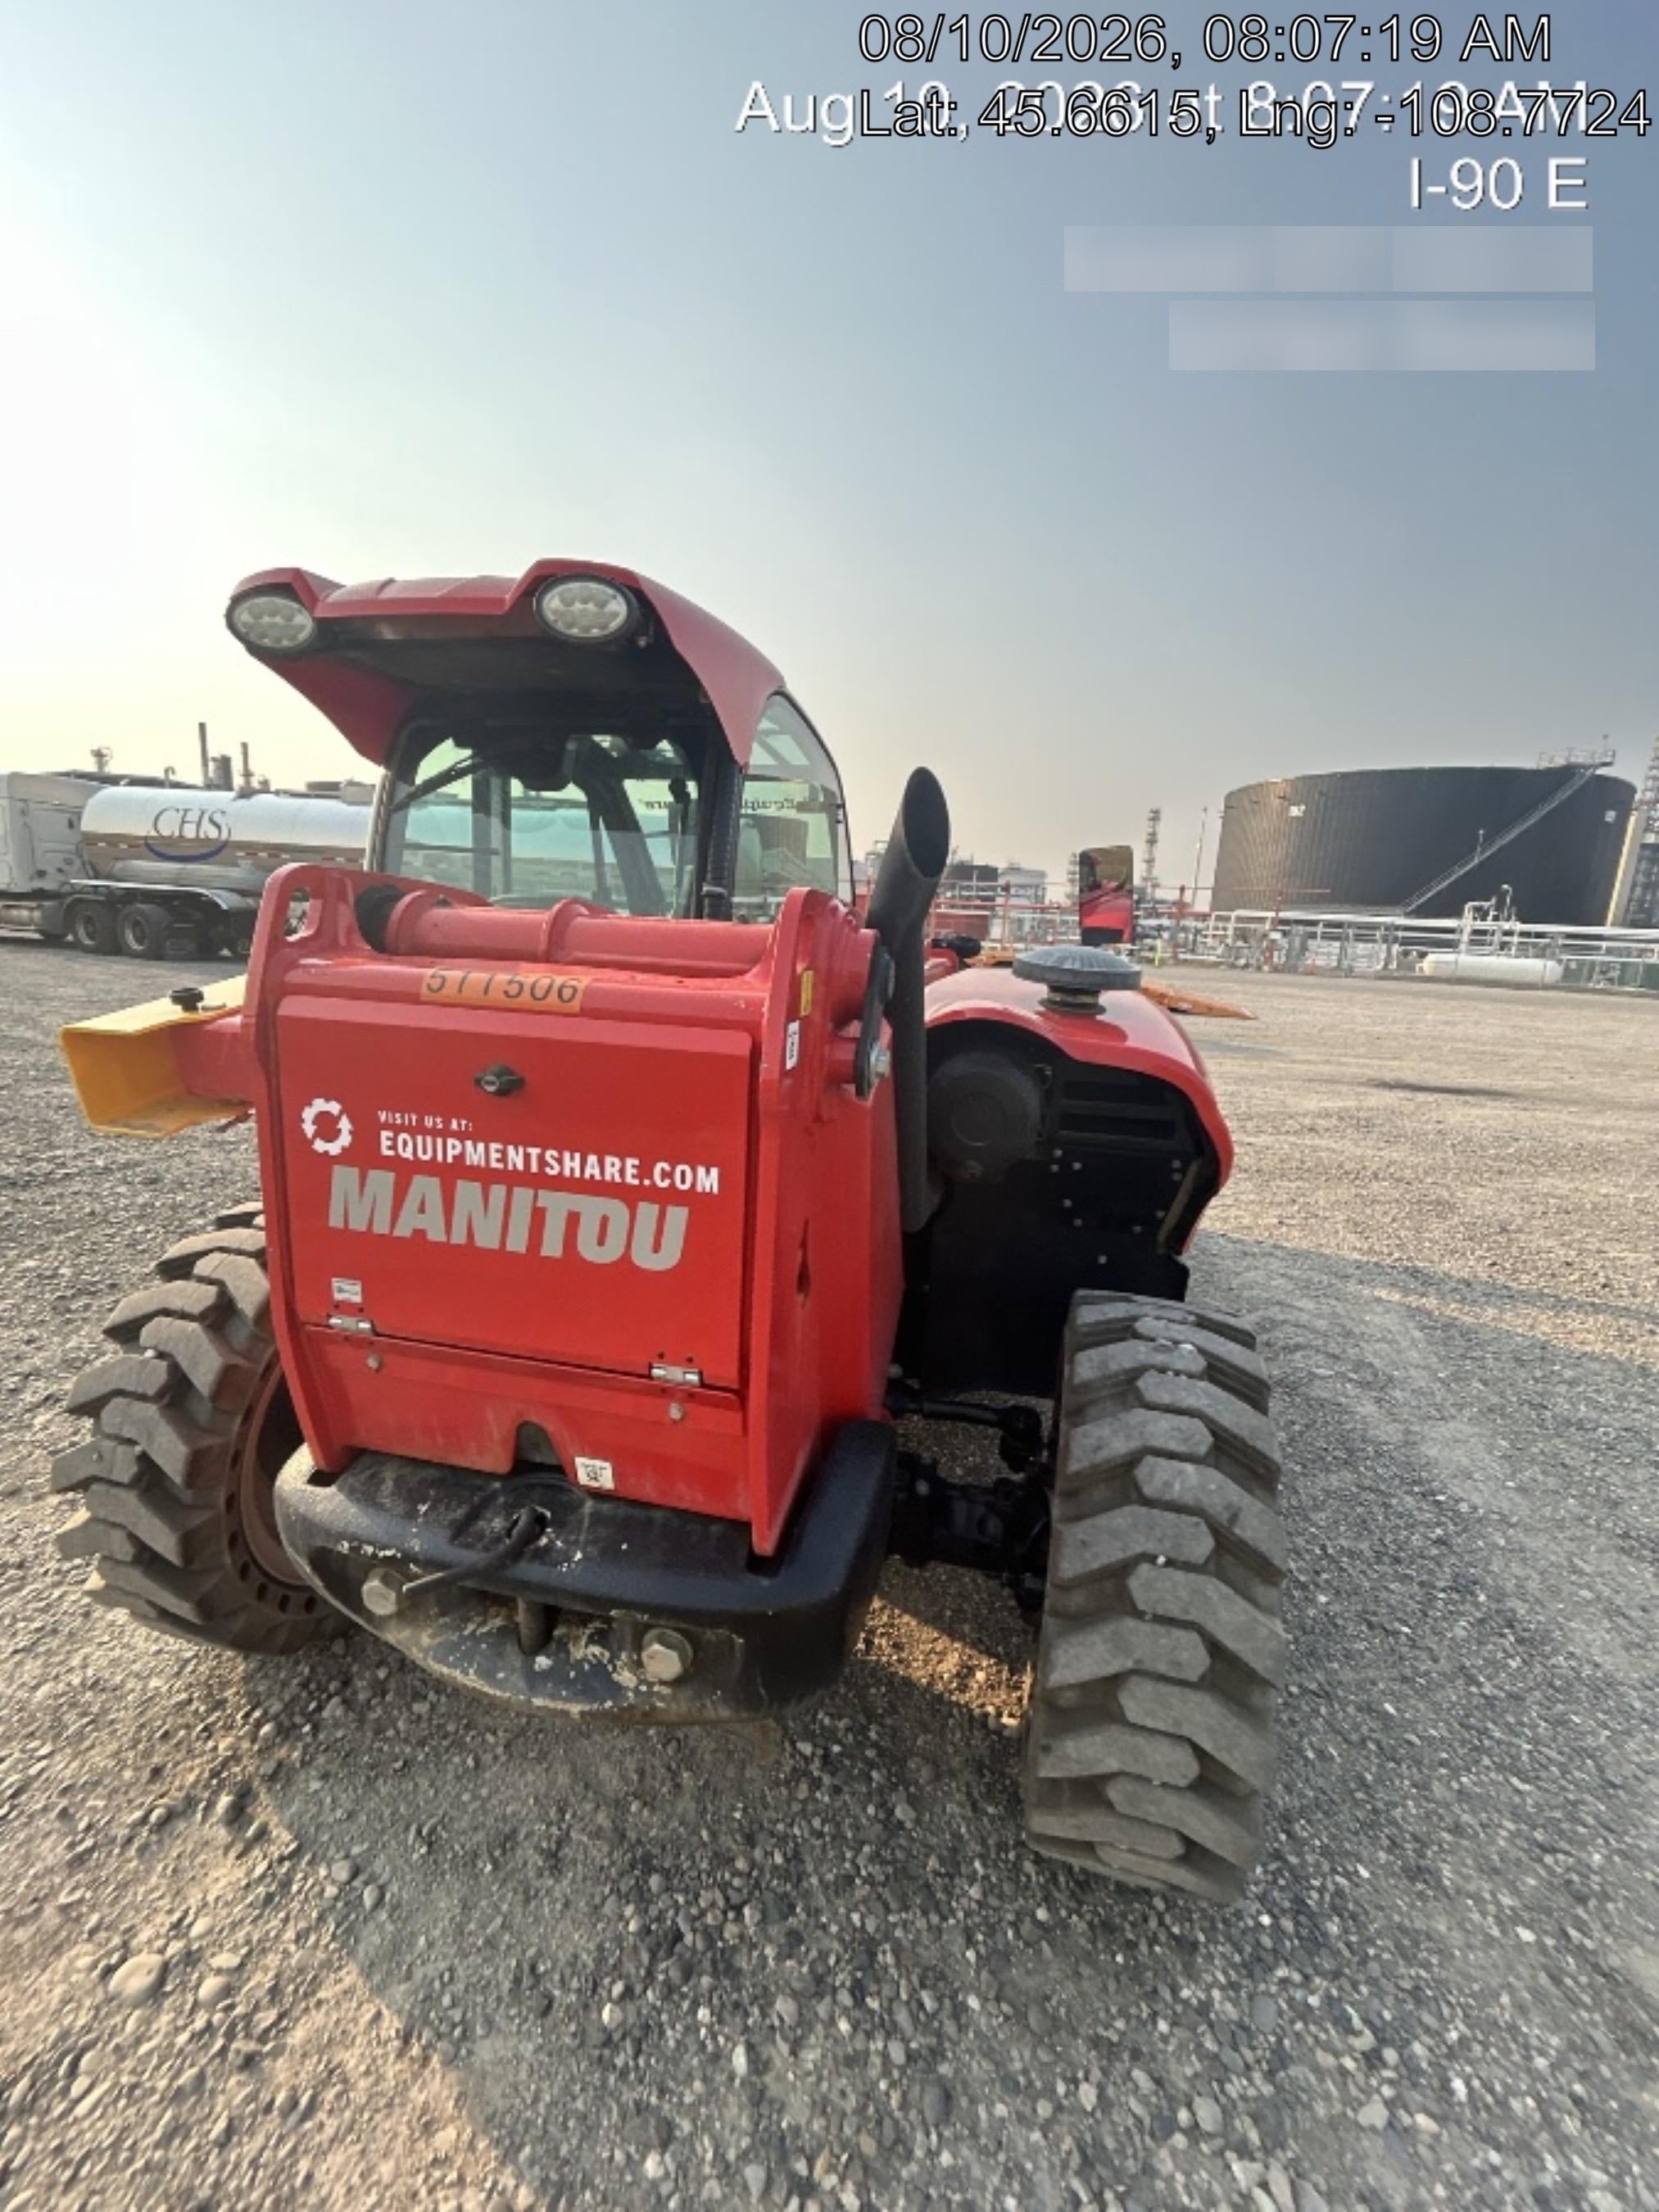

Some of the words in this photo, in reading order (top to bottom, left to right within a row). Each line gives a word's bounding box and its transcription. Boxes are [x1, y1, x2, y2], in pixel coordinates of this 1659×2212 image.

[152, 805, 228, 840] CHS
[378, 1110, 417, 1126] VISIT
[424, 1115, 443, 1129] US
[451, 1118, 473, 1131] AT:
[379, 1130, 719, 1194] EQUIPMENTSHARE.COM
[329, 1165, 690, 1271] MANITOU
